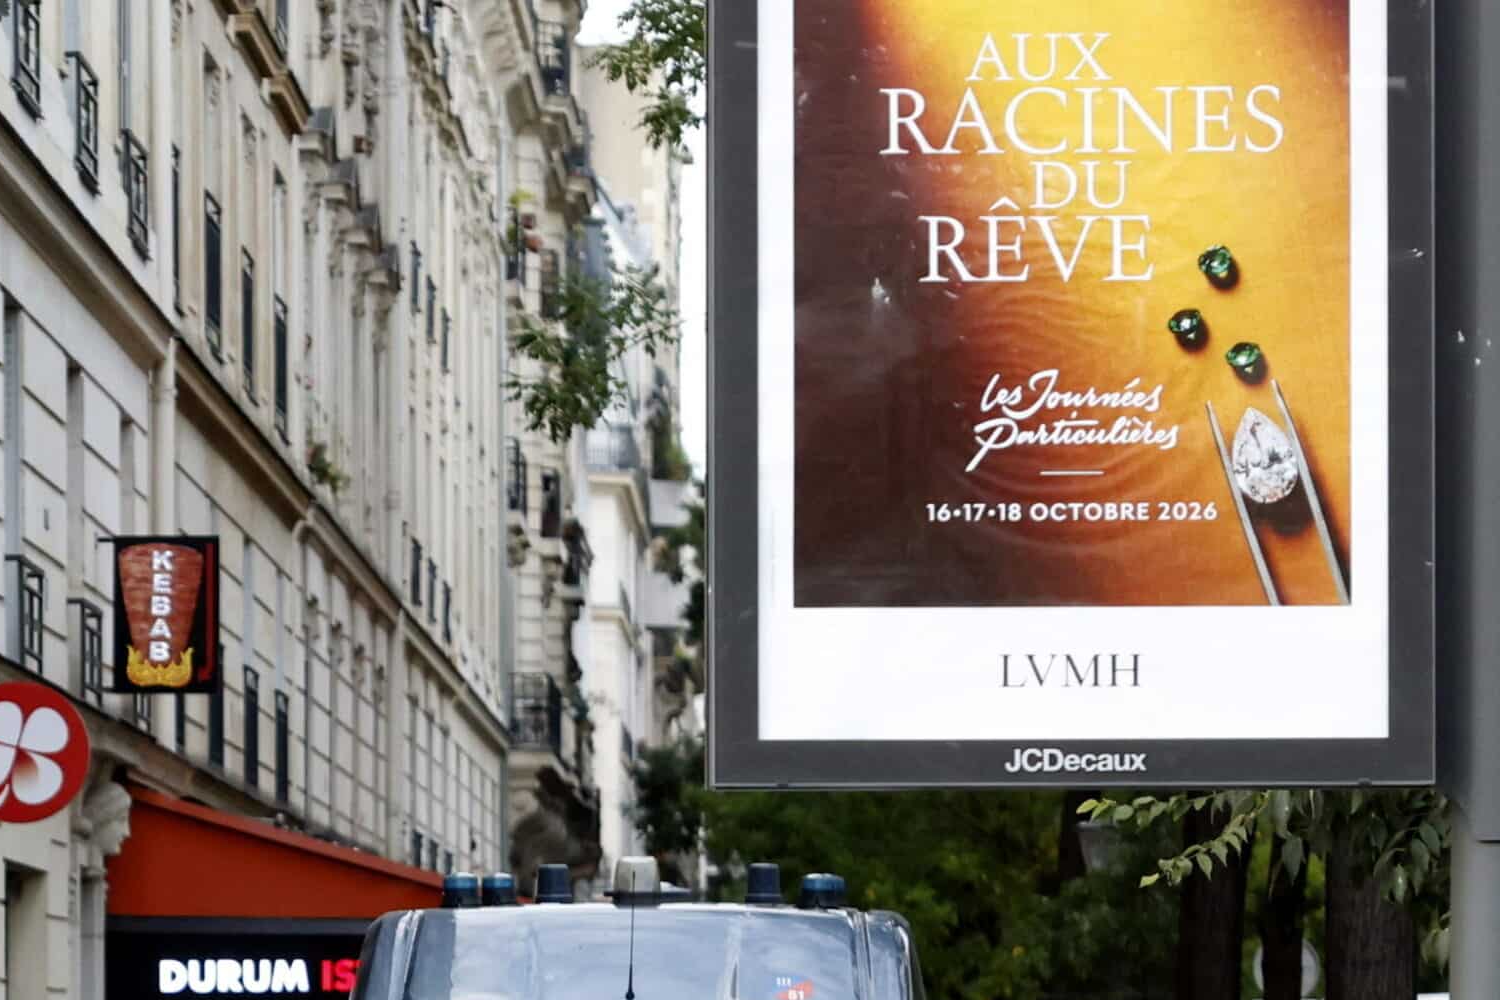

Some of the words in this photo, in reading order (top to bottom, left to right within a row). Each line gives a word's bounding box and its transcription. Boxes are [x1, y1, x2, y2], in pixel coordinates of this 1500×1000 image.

[964, 32, 1112, 82] AUX
[878, 84, 1286, 155] RACINES
[1029, 159, 1133, 210] DU
[918, 196, 1156, 283] RÊVE
[1002, 369, 1164, 420] Journées
[965, 411, 1179, 472] Particulières
[1029, 502, 1150, 521] OCTOBRE
[1157, 501, 1218, 521] 2026
[150, 550, 173, 662] KEBAB
[999, 653, 1143, 688] LVMH
[1004, 747, 1148, 772] JCDecaux
[158, 958, 310, 993] DURUM
